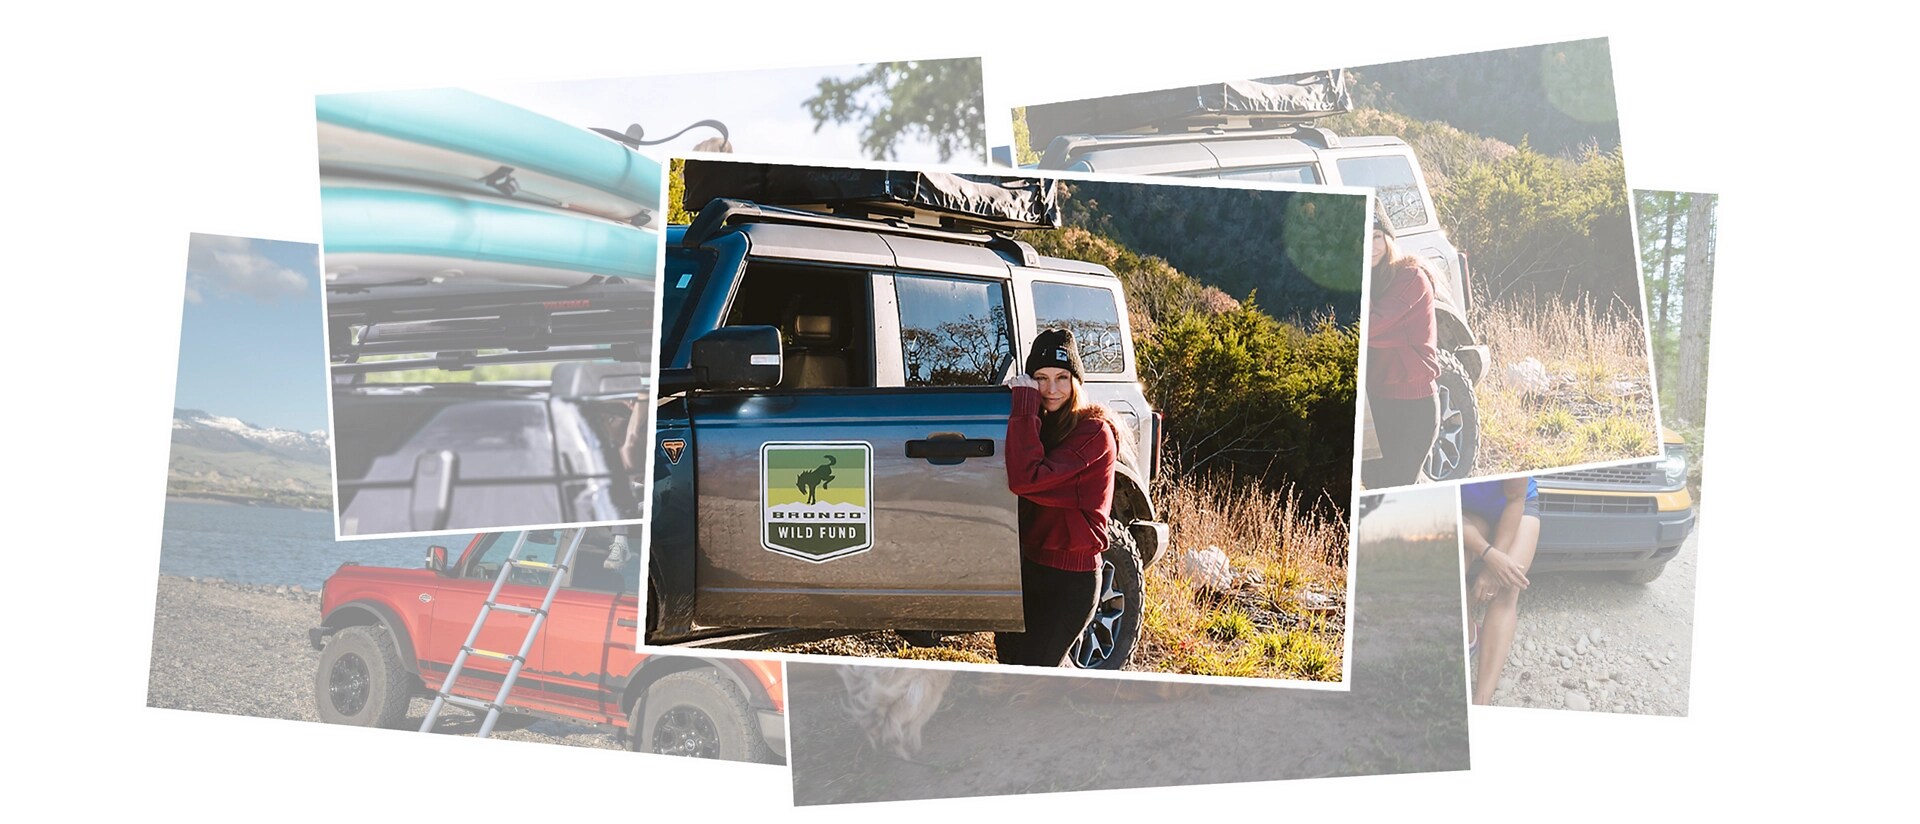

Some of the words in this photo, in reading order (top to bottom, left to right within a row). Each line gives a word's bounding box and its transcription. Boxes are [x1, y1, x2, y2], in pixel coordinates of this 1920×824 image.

[772, 511, 861, 519] BRONCO
[778, 526, 813, 539] WILD
[819, 526, 857, 539] FUND
